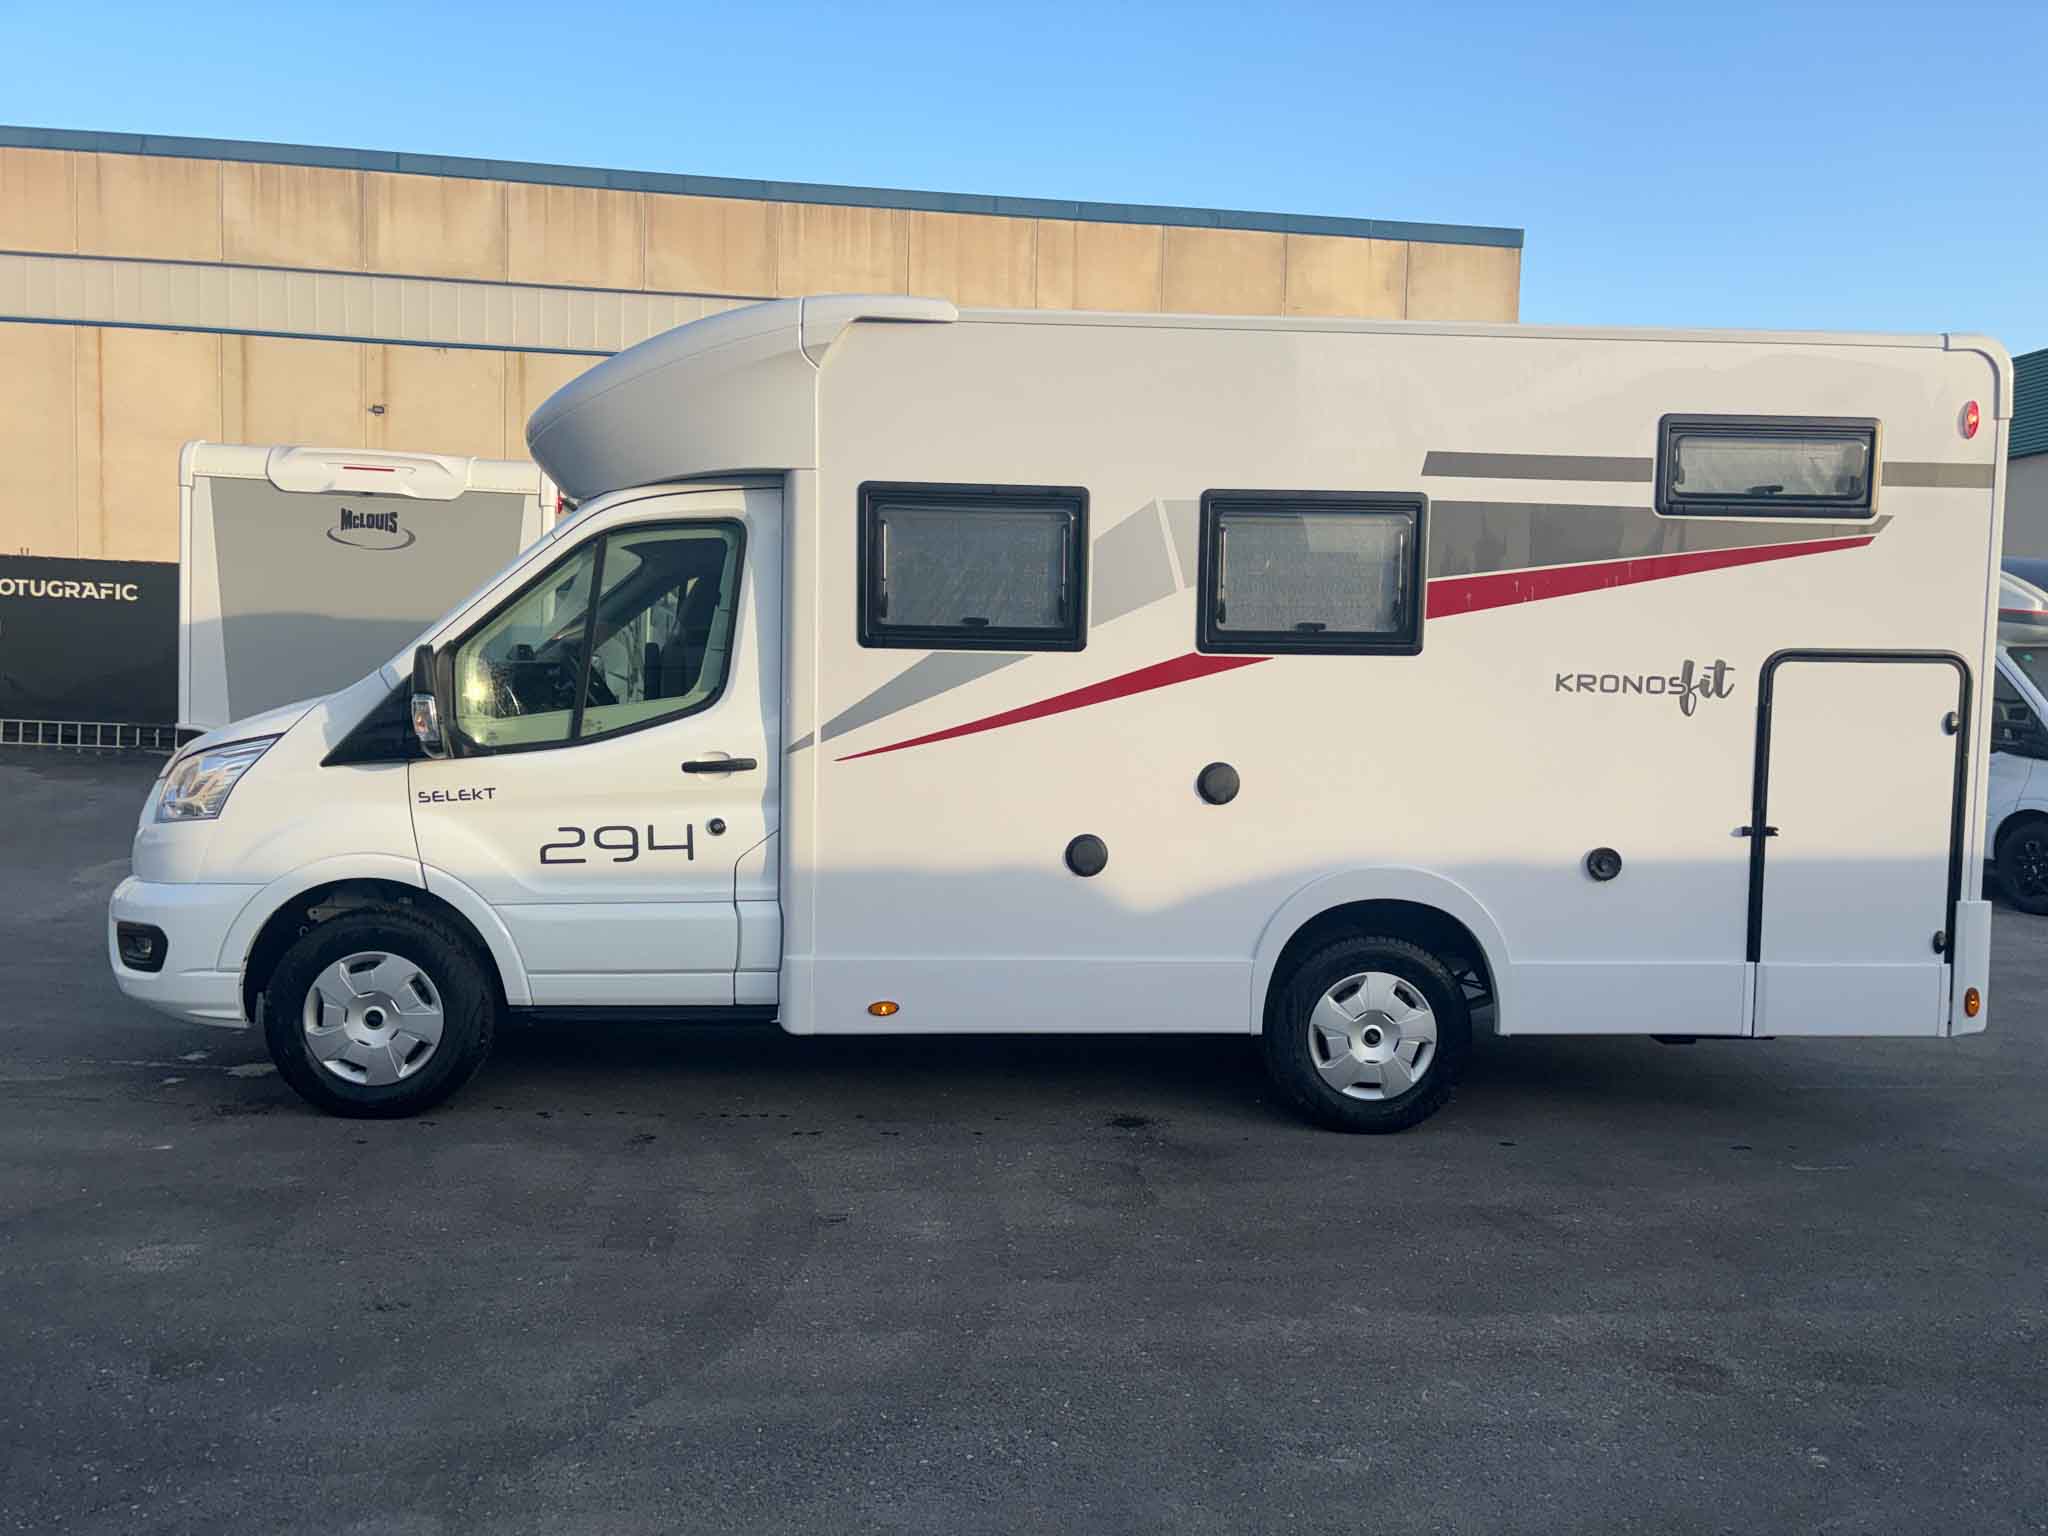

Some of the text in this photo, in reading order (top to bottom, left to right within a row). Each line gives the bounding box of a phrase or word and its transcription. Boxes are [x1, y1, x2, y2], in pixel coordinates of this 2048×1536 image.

[340, 507, 399, 534] McLOUIS
[0, 578, 139, 601] OTUGRAFIC
[540, 823, 694, 865] 294
